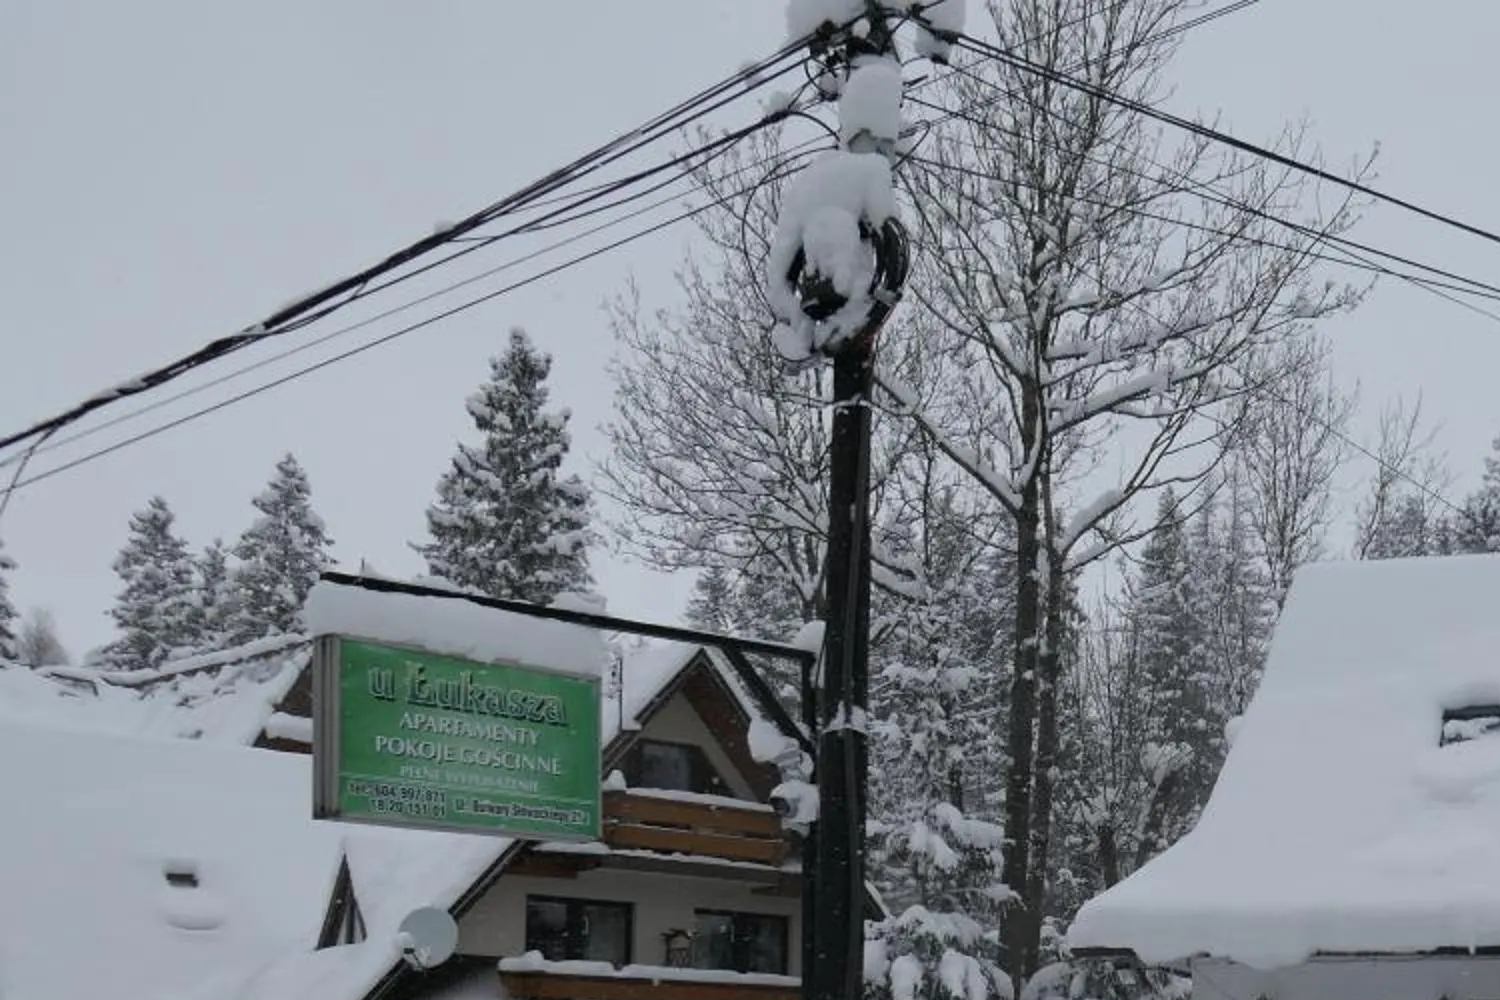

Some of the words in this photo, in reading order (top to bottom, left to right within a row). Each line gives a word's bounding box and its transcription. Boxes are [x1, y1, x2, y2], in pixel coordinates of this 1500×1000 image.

[403, 660, 568, 726] Łukasza
[400, 711, 543, 746] APARTAMENTY
[375, 734, 453, 765] POKOJE
[459, 743, 562, 776] GOŚCINNE
